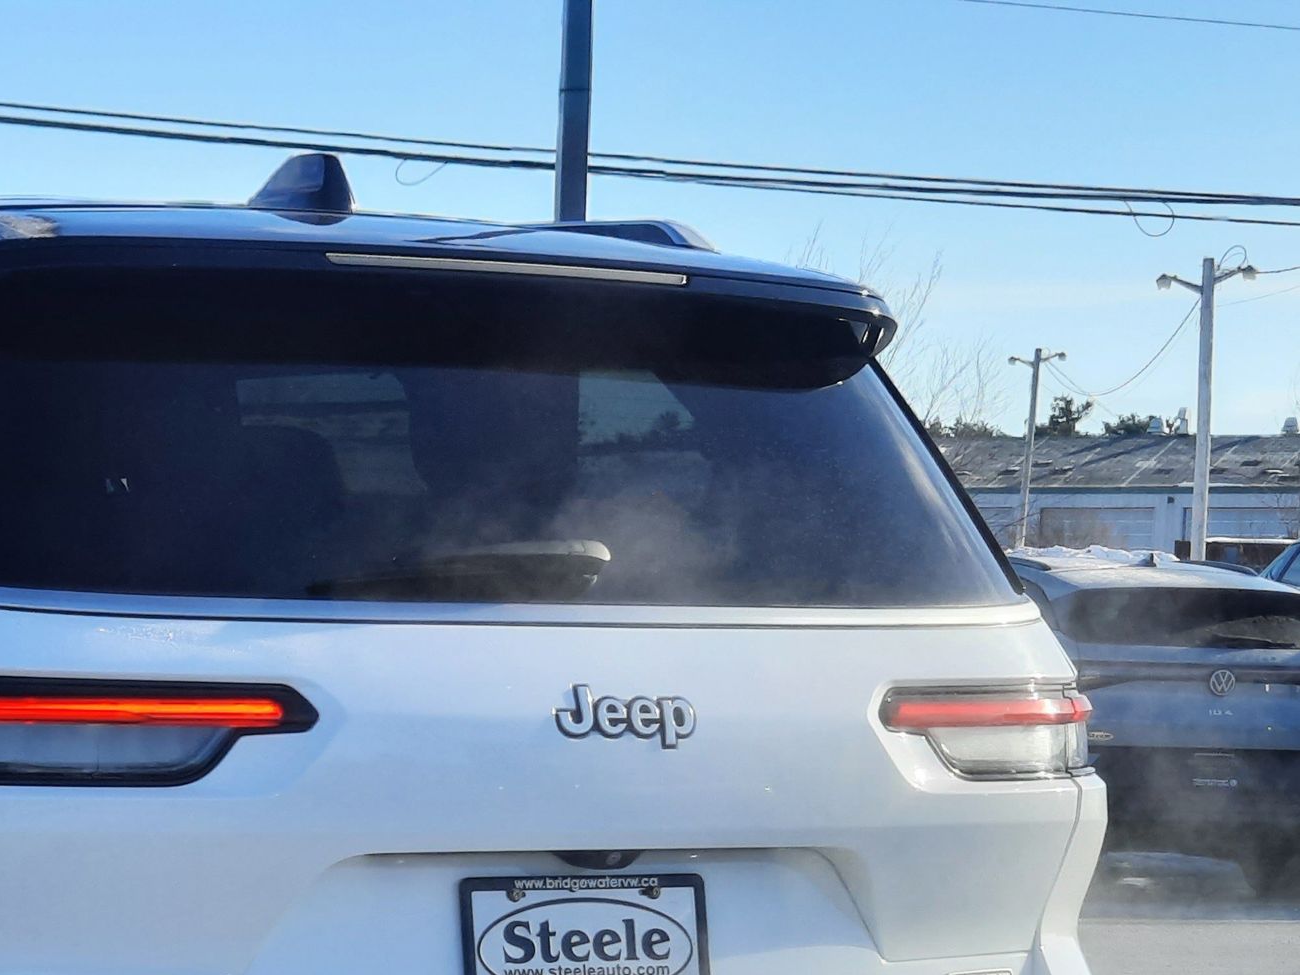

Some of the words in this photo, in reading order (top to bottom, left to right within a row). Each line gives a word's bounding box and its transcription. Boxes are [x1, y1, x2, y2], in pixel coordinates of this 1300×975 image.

[550, 682, 697, 750] Jeep
[513, 876, 659, 891] www.bridgewatervw.ca
[502, 918, 671, 964] Steele
